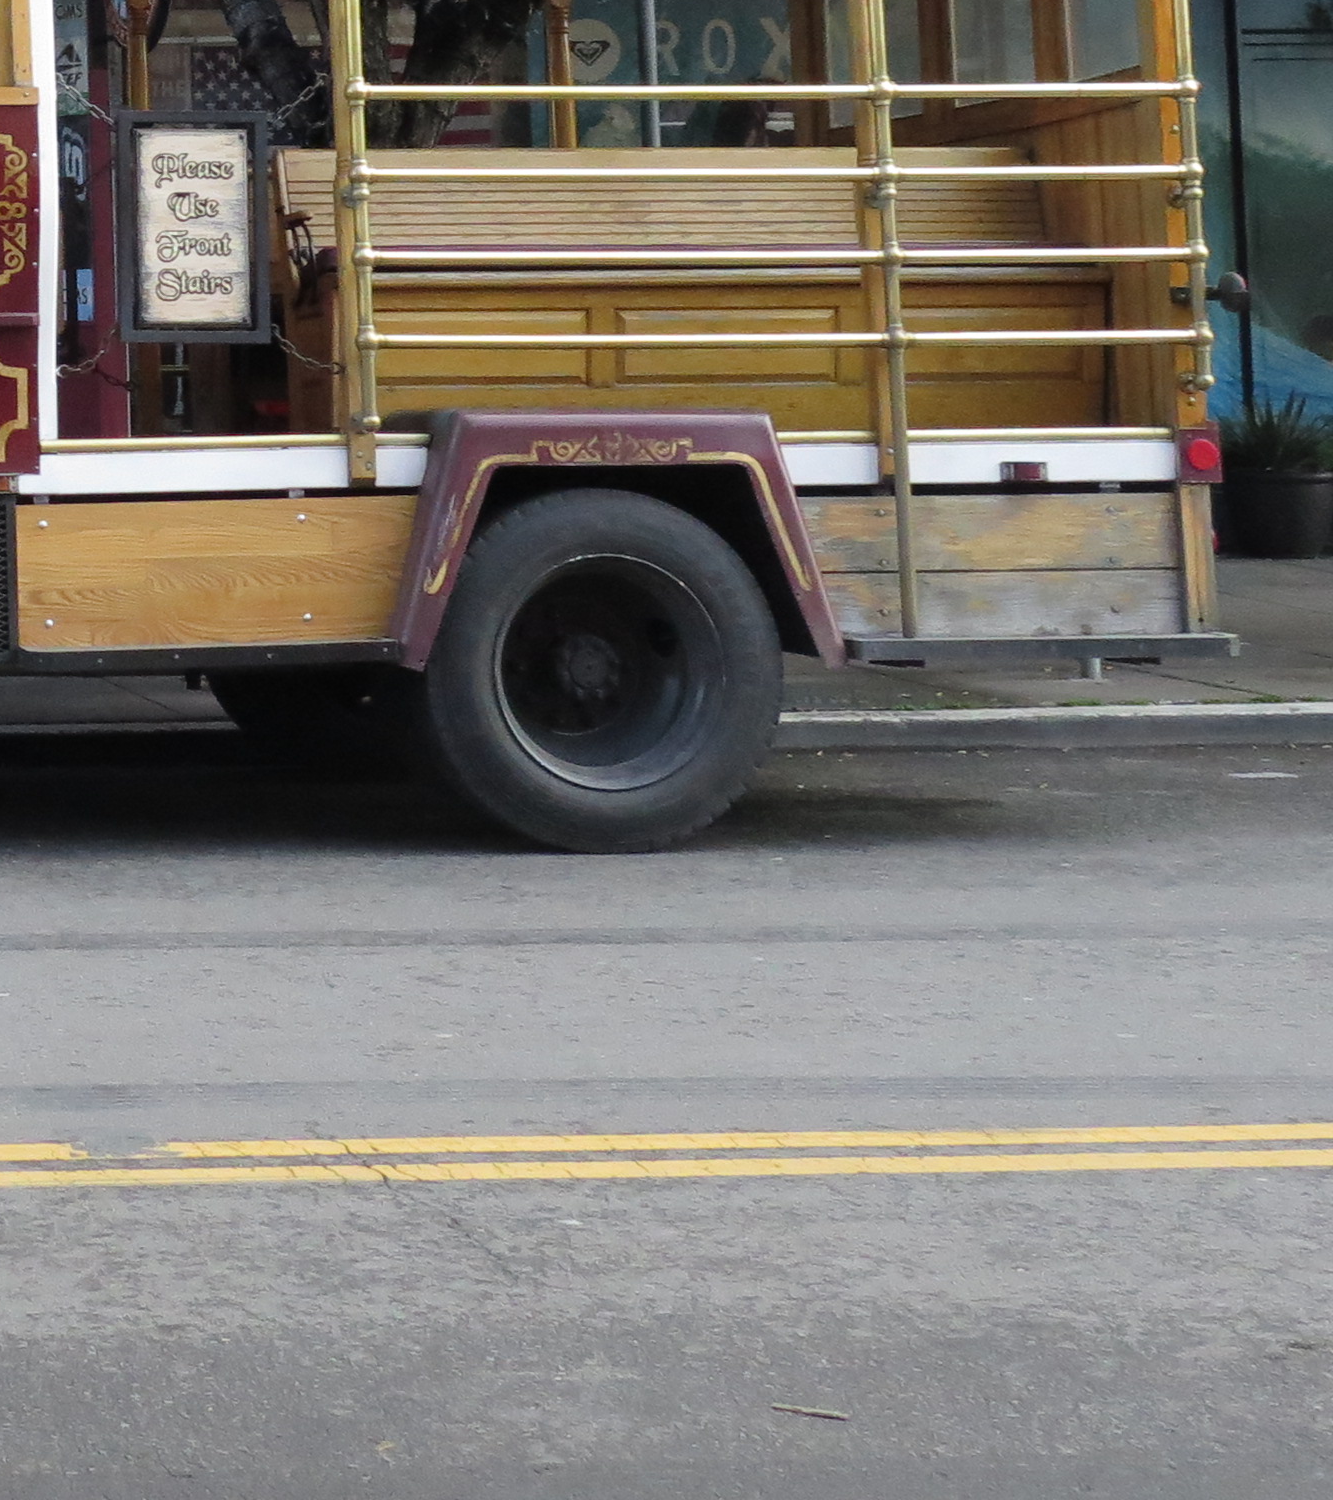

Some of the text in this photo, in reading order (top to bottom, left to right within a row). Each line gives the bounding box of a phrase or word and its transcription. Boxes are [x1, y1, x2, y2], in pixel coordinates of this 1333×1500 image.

[152, 153, 234, 188] Please
[166, 192, 219, 221] Use
[155, 230, 232, 262] Front
[156, 268, 233, 301] Stairs
